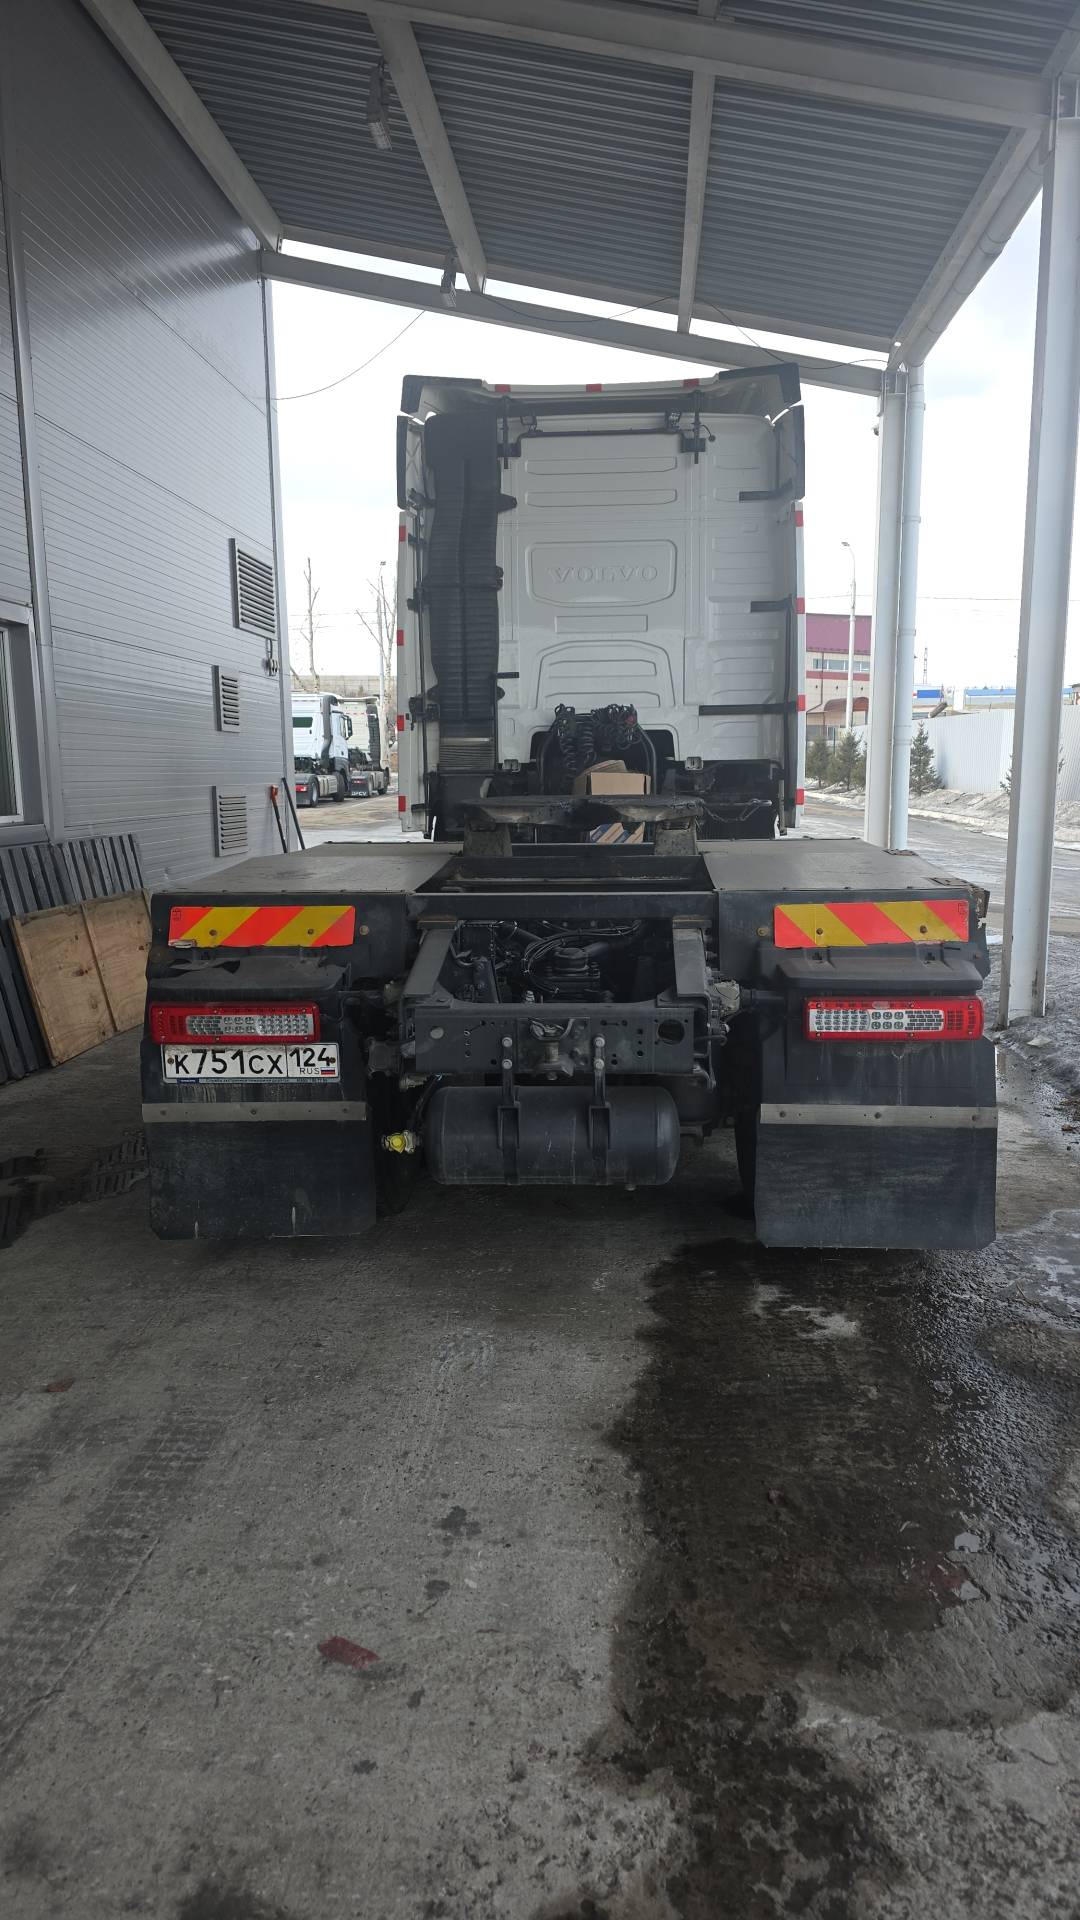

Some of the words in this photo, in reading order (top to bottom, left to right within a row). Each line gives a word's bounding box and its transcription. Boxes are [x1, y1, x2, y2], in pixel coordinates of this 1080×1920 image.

[548, 566, 659, 583] VOLVO
[290, 1047, 331, 1067] 124
[299, 1067, 320, 1075] RUS
